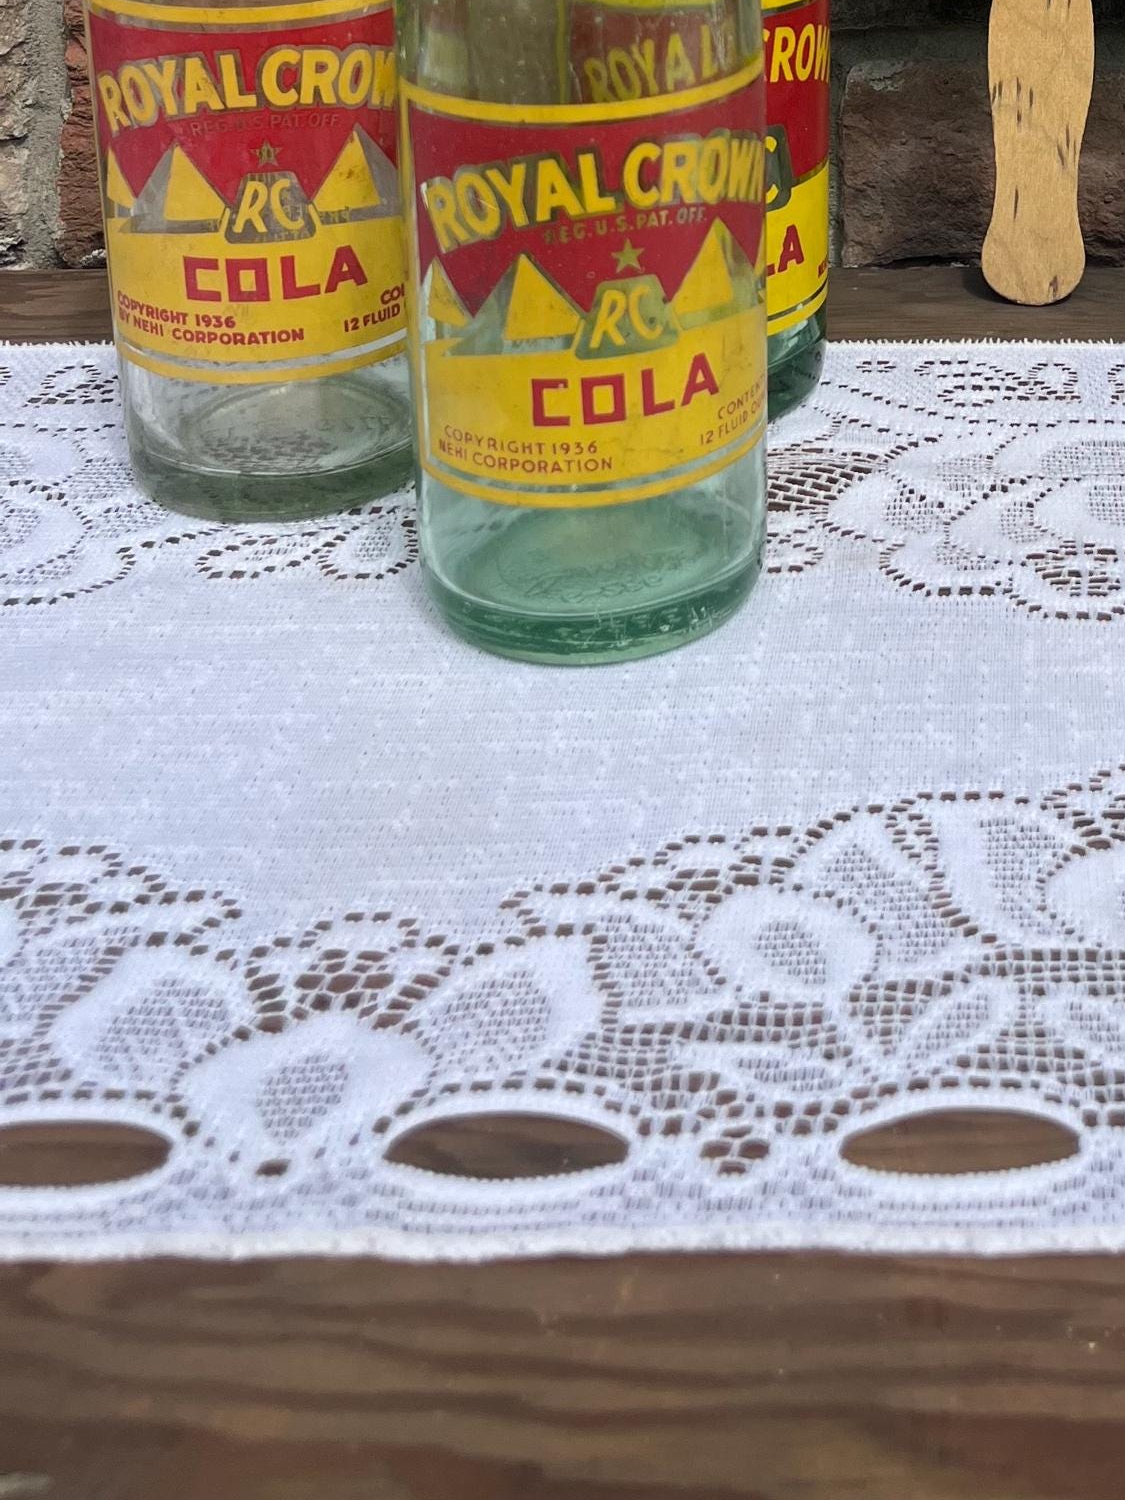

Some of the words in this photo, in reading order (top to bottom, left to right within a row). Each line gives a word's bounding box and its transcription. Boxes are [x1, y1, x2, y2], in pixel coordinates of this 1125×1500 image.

[584, 25, 718, 106] ROYAL
[99, 54, 258, 135] ROYAL
[260, 49, 397, 111] CROW
[309, 112, 340, 128] OFF
[232, 177, 306, 235] RC
[424, 153, 617, 256] ROYAL
[635, 209, 674, 230] PAT.
[182, 244, 369, 304] COLA
[117, 289, 188, 327] COPYRIGHT
[195, 313, 237, 330] 1936
[343, 318, 360, 333] 12
[363, 302, 401, 327] FLUID
[590, 285, 666, 350] RC
[133, 315, 165, 338] NEHI
[172, 327, 305, 347] CORPORATION
[531, 352, 720, 428] COLA
[444, 424, 546, 455] COPYRIGHT
[551, 440, 599, 455] 1936
[700, 429, 714, 445] 12
[717, 409, 748, 438] FLUID
[438, 437, 468, 462] NEHI
[471, 451, 613, 474] CORPORATION
